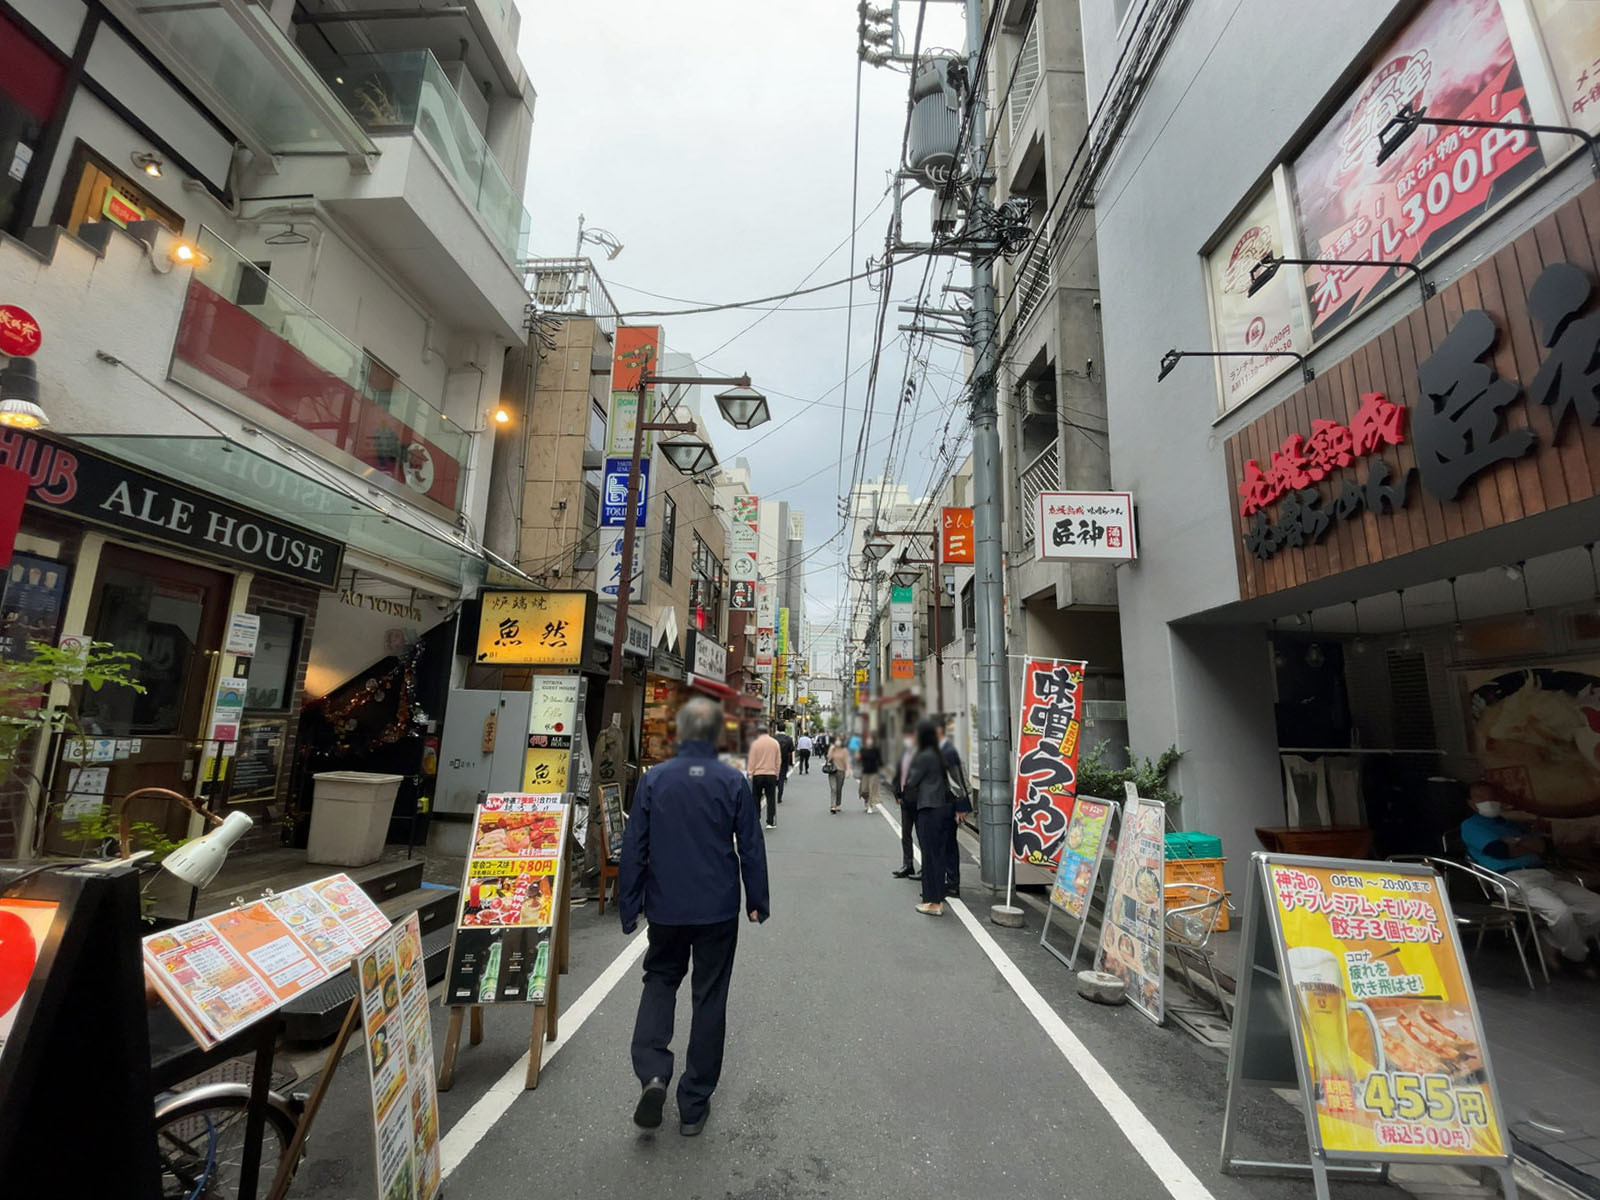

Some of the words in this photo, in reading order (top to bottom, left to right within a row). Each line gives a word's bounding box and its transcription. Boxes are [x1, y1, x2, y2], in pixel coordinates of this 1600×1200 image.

[100, 481, 194, 534] ALE
[203, 510, 324, 573] HOUSE
[944, 515, 974, 529] とん
[1053, 518, 1105, 547] 匠神
[1275, 870, 1319, 890] 神泡の
[1331, 875, 1363, 887] OPEN
[1381, 878, 1431, 893] 20:00まで
[1346, 951, 1371, 963] コロナ
[1349, 962, 1388, 979] 疲れを
[1364, 1073, 1487, 1124] 455円
